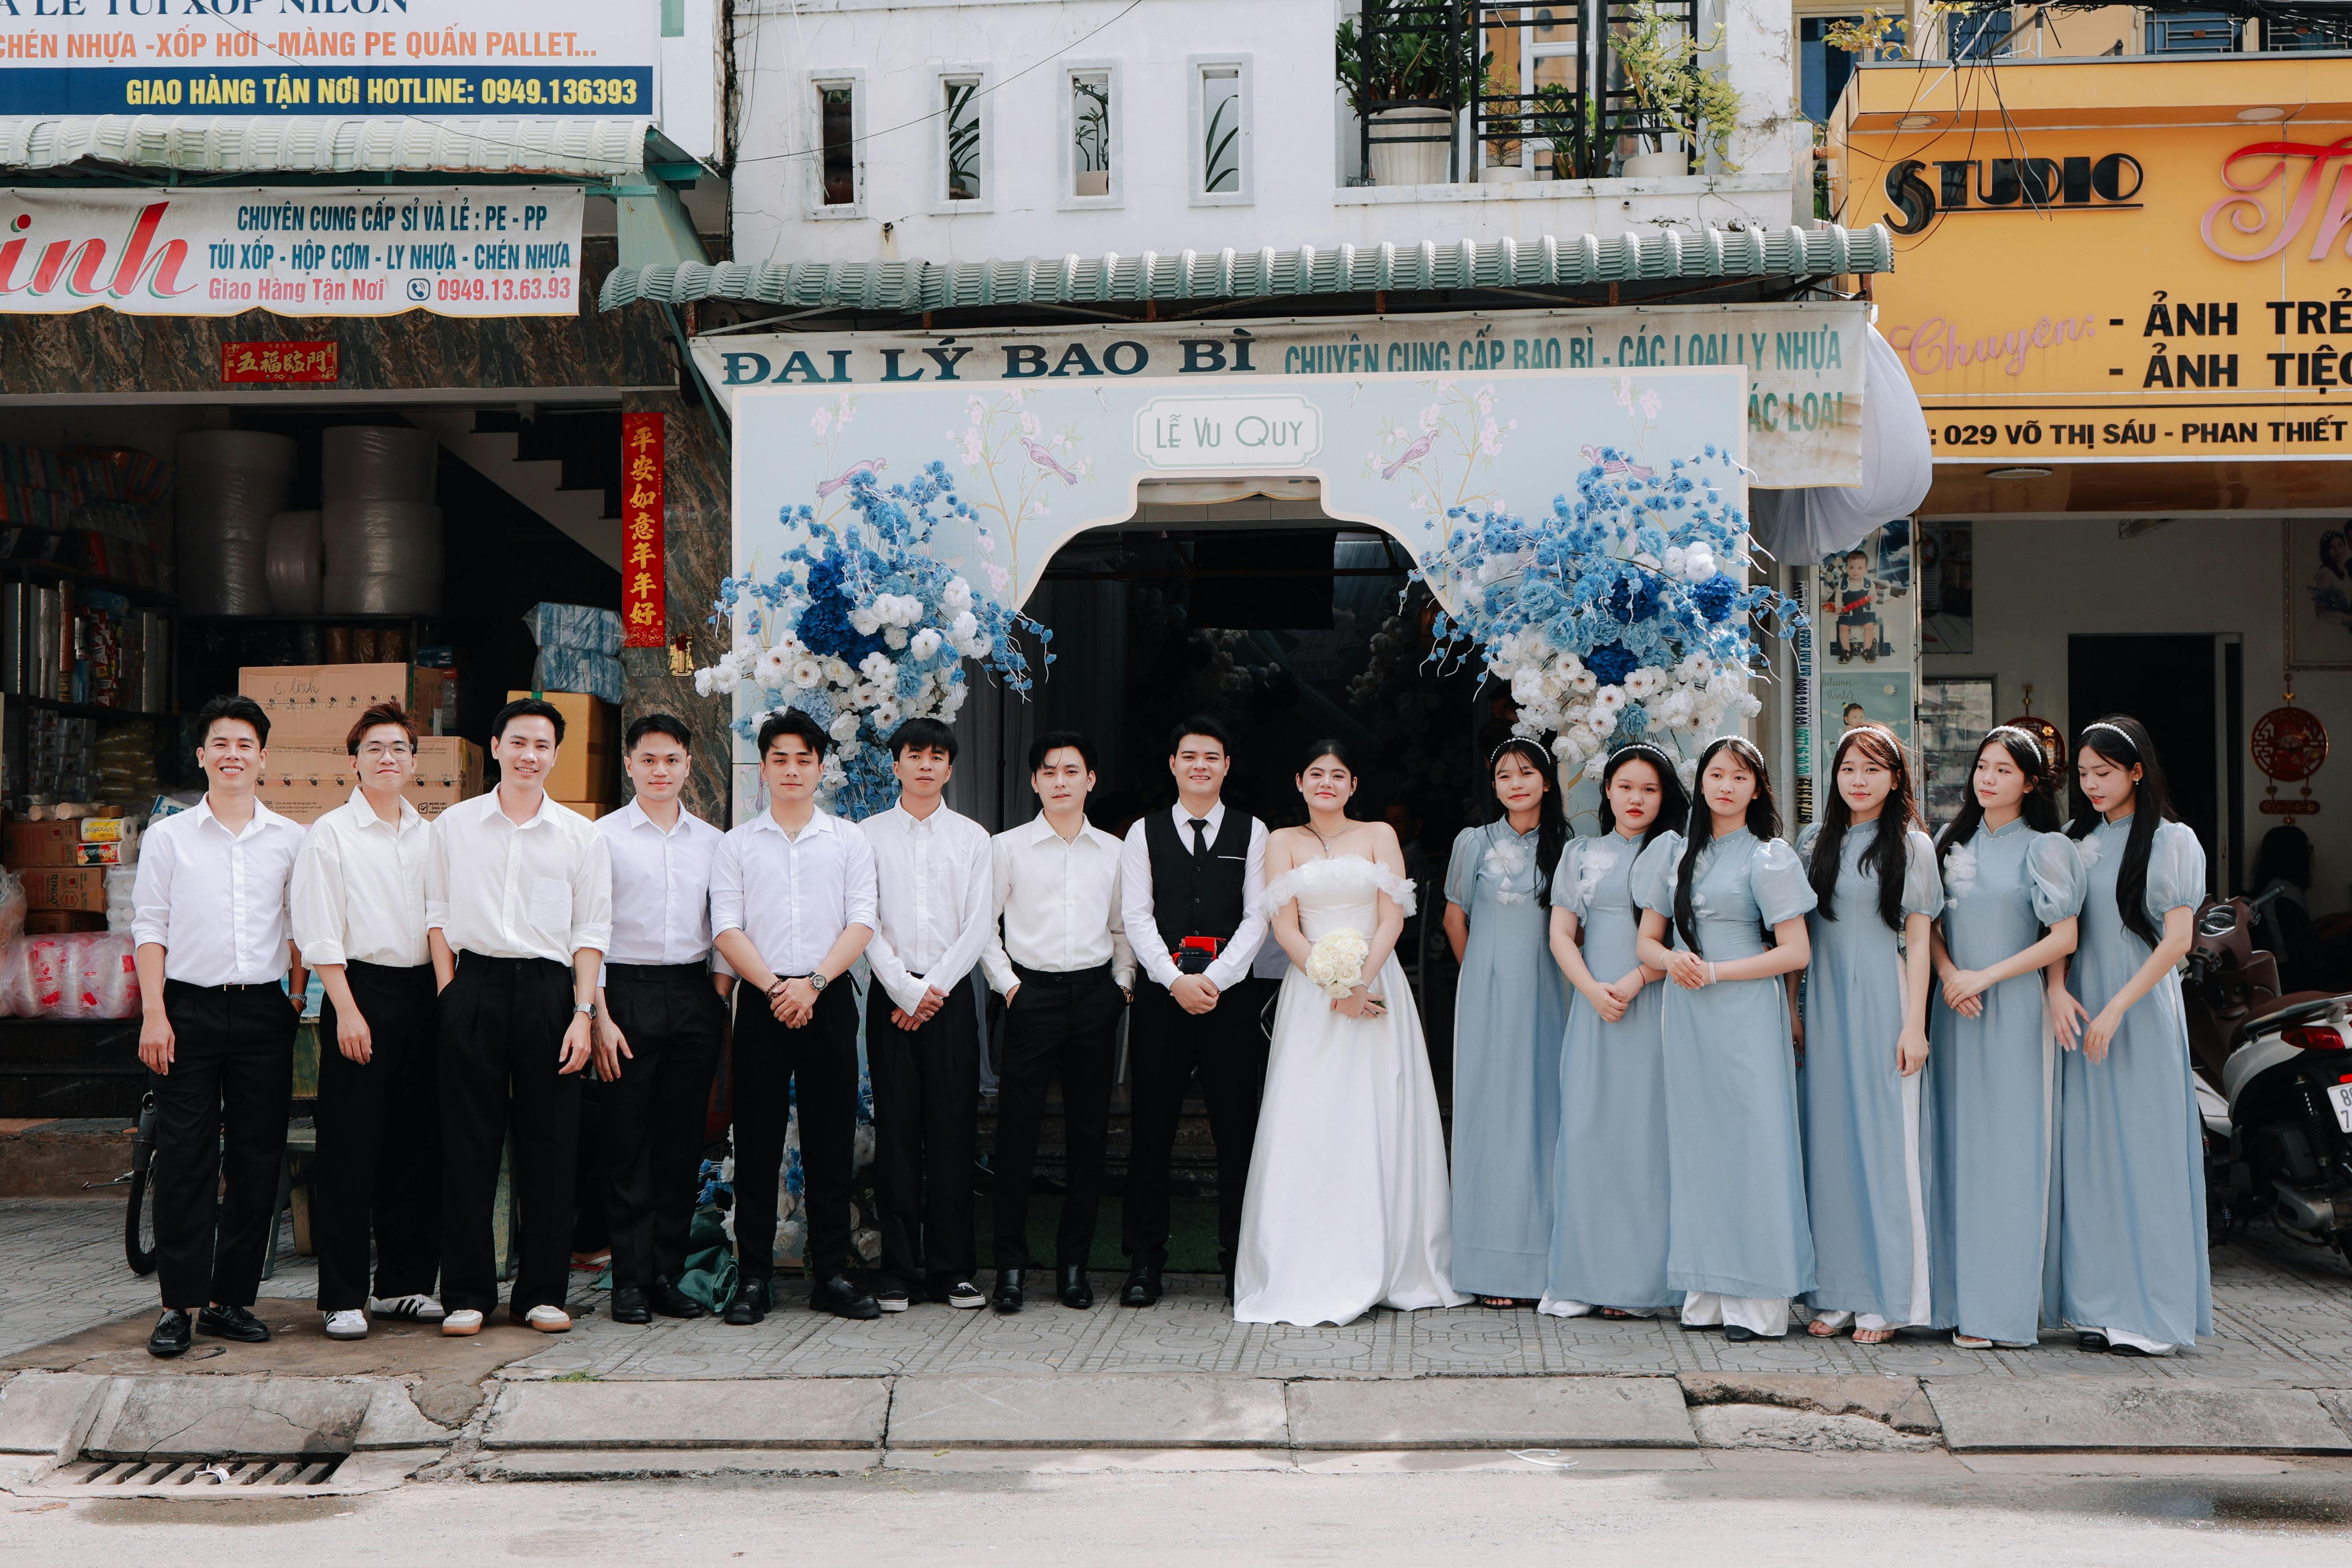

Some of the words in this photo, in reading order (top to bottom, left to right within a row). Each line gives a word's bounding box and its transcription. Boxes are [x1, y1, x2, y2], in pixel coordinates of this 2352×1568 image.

[67, 30, 137, 63] NHỰA
[217, 30, 258, 57] HƠI
[365, 31, 396, 56] PE
[407, 22, 476, 59] QUẤN
[486, 32, 596, 56] PALLET...
[126, 79, 181, 105] GIAO
[189, 74, 256, 104] HÀNG
[263, 73, 310, 109] TẬN
[318, 76, 360, 104] NƠI
[367, 78, 474, 104] HOTLINE:
[482, 78, 637, 104] 0949.136393
[237, 201, 304, 231] CHUYÊN
[310, 205, 356, 231] CUNG
[362, 196, 395, 231] CẤP
[401, 197, 417, 230] SỈ
[423, 200, 445, 231] VÀ
[451, 197, 469, 230] LẺ
[485, 205, 507, 230] PE
[525, 205, 547, 230] PP
[1881, 153, 2143, 237] STUDIO
[208, 238, 234, 269] TÚI
[240, 235, 274, 269] XỐP
[292, 239, 325, 275] HỘP
[331, 242, 369, 270] CƠM
[387, 245, 405, 270] LY
[409, 241, 456, 275] NHỰA
[474, 239, 519, 270] CHÉN
[526, 240, 570, 274] NHỰA
[208, 278, 251, 300] Giao
[258, 278, 305, 303] Hàng
[313, 278, 345, 305] Tận
[352, 278, 384, 300] Nơi
[437, 277, 570, 302] 0949.13.63.93
[2143, 291, 2237, 337] ẢNH
[2266, 288, 2352, 334] TRẺ
[236, 350, 326, 373] 五福臨門
[880, 337, 974, 382] LÝ
[1001, 341, 1149, 378] BAO
[1178, 328, 1256, 373] BÌ
[1285, 334, 1379, 374] CHUYÊN
[1388, 341, 1450, 372] CUNG
[1459, 324, 1505, 371] CẤP
[1514, 337, 1561, 369] BAO
[1570, 326, 1593, 368] BÌ
[1619, 325, 1665, 367] CÁC
[1738, 333, 1767, 371] LY
[1777, 323, 1841, 378] NHỰA
[1889, 315, 2095, 375] Chuyên:
[2143, 342, 2237, 388] ẢNH
[1748, 383, 1778, 433] ÁC
[1788, 391, 1844, 437] LOẠI
[1156, 414, 1181, 449] LỄ
[1193, 417, 1220, 448] VU
[1235, 415, 1303, 447] QUY
[1944, 425, 1997, 445] 029
[2005, 420, 2042, 445] VÕ
[2050, 424, 2094, 449] THỊ
[2103, 419, 2156, 444] SÁU
[2182, 423, 2257, 443] PHAN
[2268, 415, 2348, 442] THIẾT
[630, 426, 656, 626] 平安如意年年好
[1827, 689, 1856, 702] Winter
